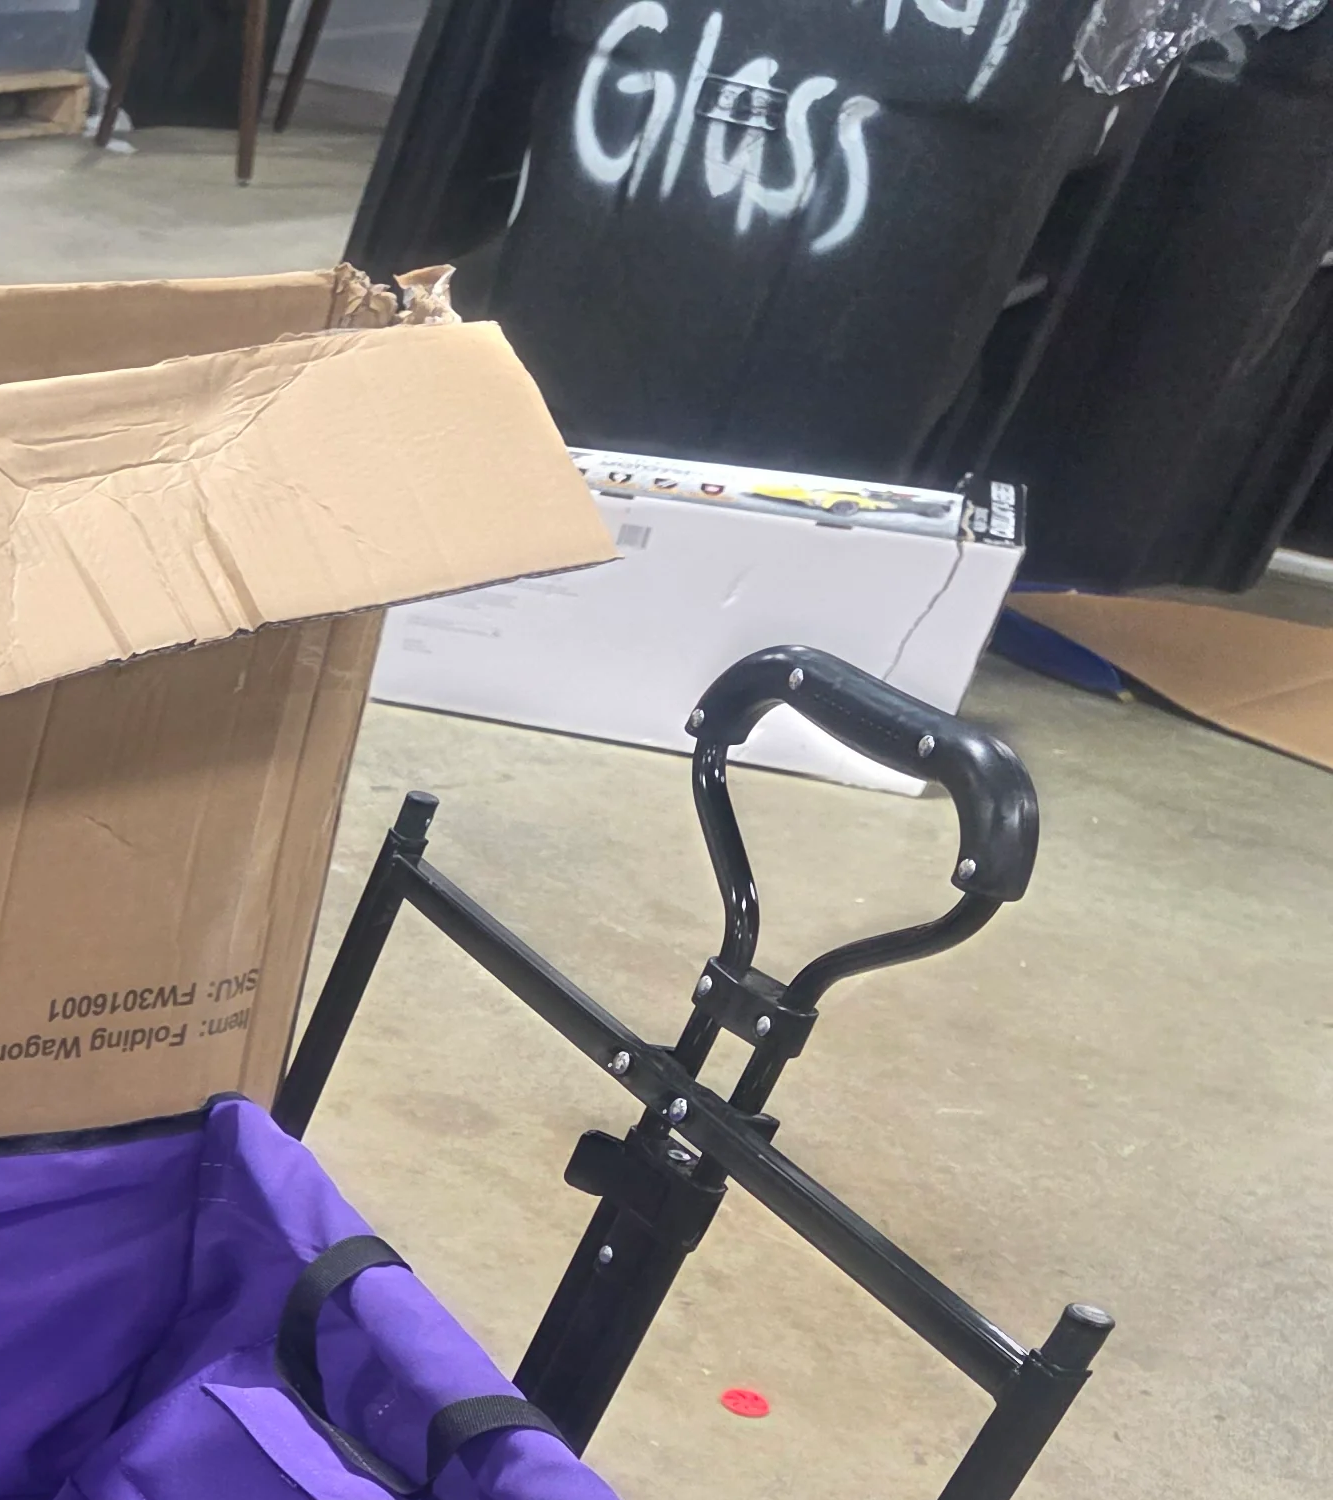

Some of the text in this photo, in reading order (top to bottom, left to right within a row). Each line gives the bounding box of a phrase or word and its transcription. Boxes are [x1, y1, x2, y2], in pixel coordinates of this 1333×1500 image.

[574, 0, 880, 254] Glass
[47, 968, 260, 1022] SKU: FW3016001
[89, 1023, 187, 1053] Folding
[200, 1007, 251, 1037] Item:
